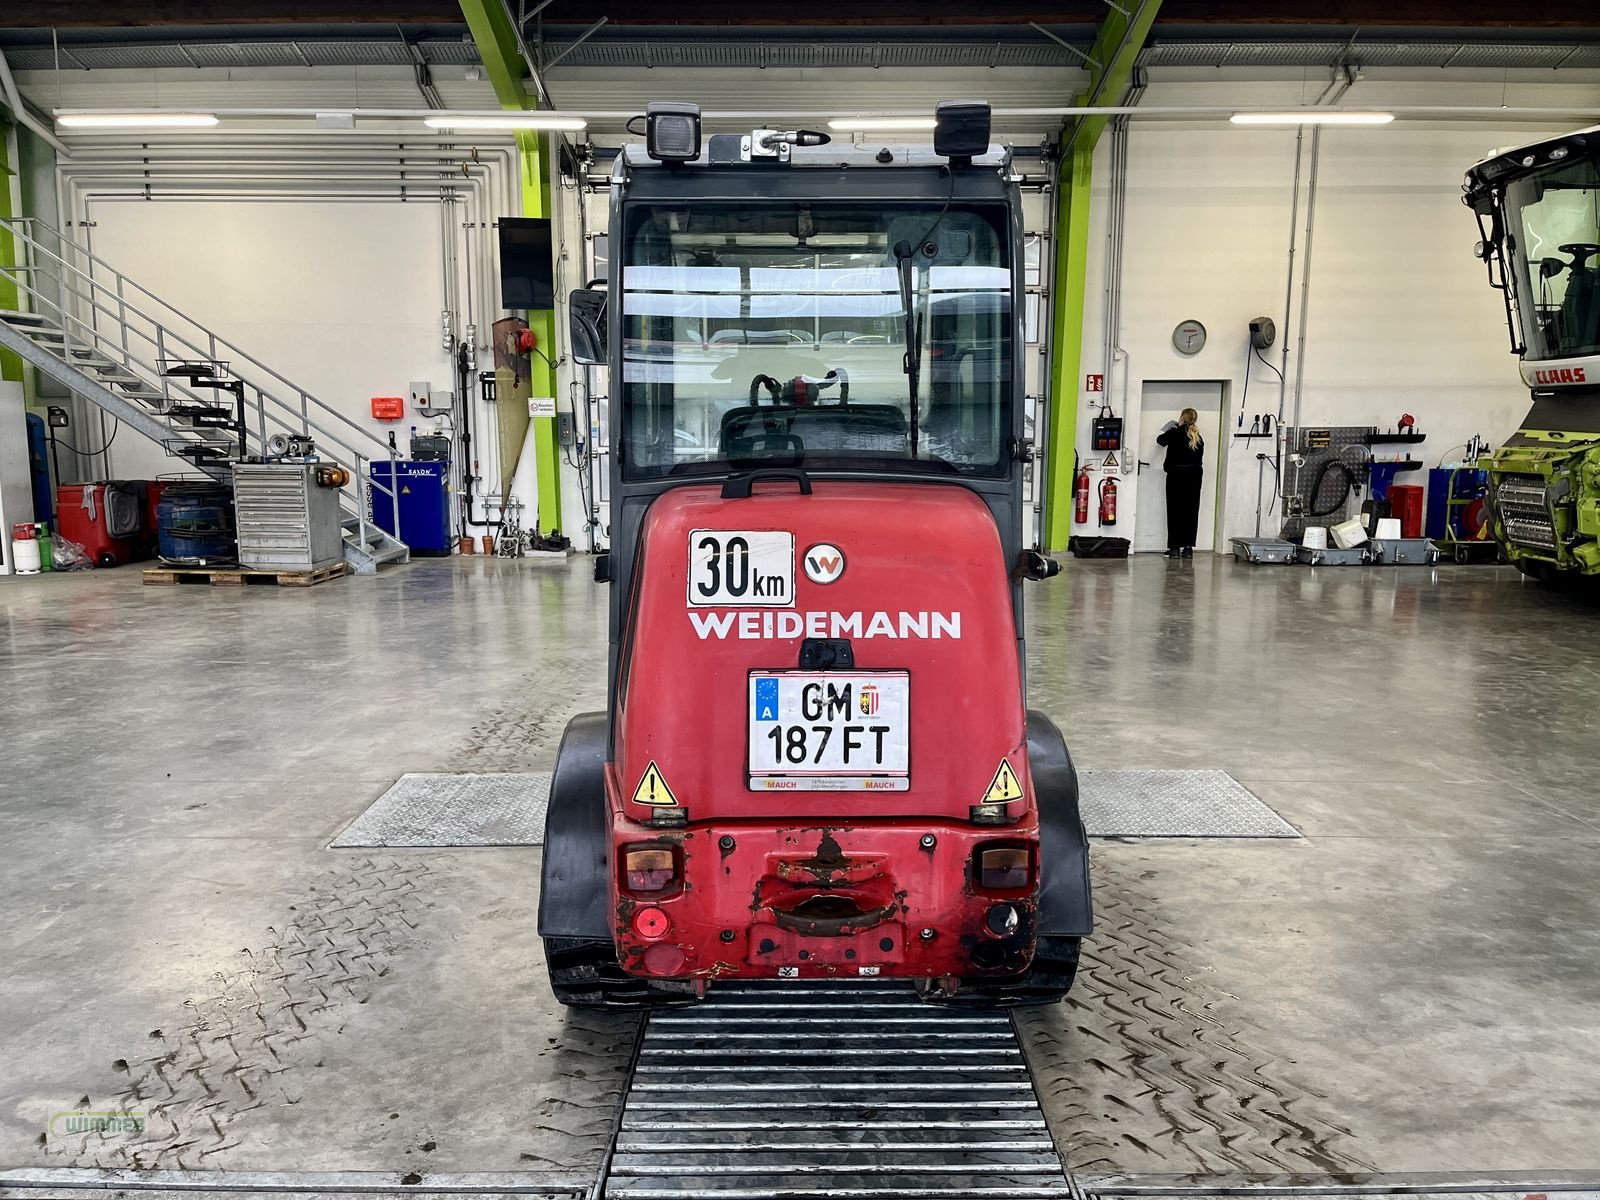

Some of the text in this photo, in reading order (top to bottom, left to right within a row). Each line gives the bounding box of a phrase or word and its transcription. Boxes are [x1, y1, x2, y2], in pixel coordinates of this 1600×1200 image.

[1535, 367, 1586, 385] CLAAS
[408, 468, 431, 478] SAXON
[697, 536, 785, 597] 30 km
[687, 611, 961, 640] WEIDEMANN
[802, 682, 852, 722] GM
[761, 706, 773, 719] A
[768, 725, 890, 764] 187 FT
[767, 781, 797, 789] MAUCH
[865, 781, 895, 789] MAUCH
